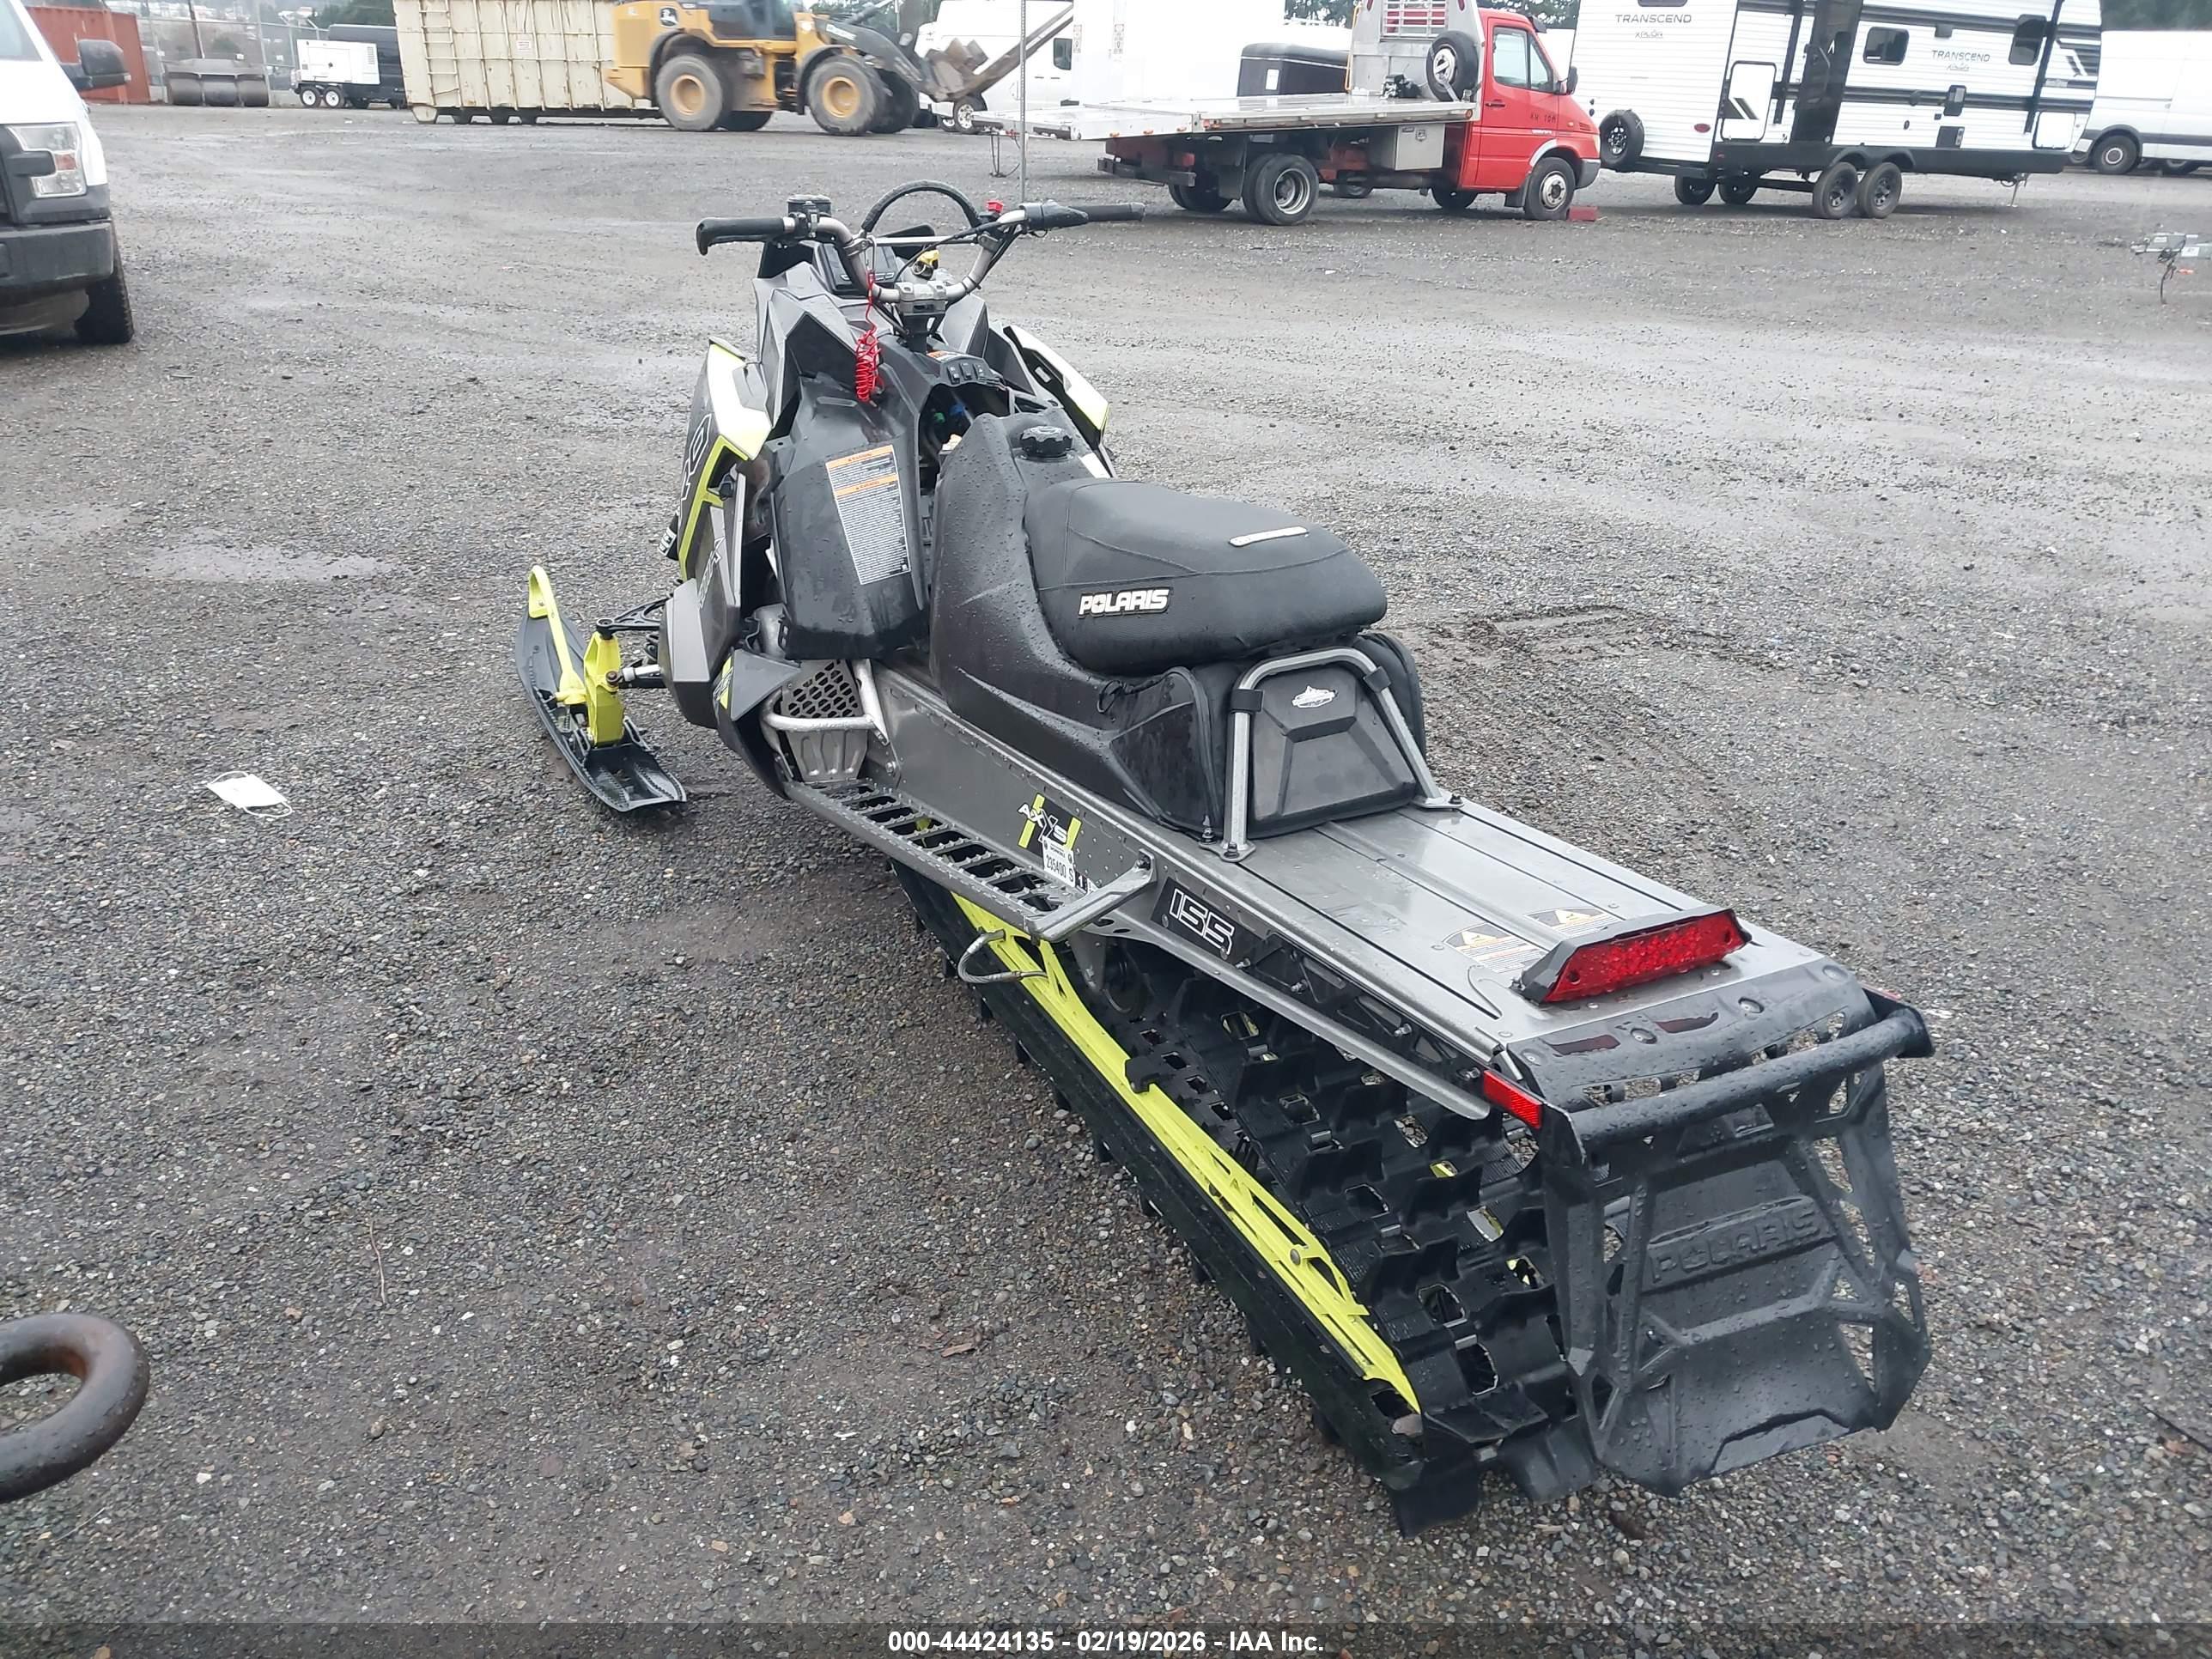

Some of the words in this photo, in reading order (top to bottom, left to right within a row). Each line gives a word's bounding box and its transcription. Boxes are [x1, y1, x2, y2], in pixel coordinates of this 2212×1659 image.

[1615, 14, 1692, 23] TRANSCEND
[1932, 50, 1990, 63] TRANSCEND
[1079, 588, 1170, 617] POLARIS
[1169, 888, 1236, 955] 155
[1650, 1206, 1821, 1285] POLARIS
